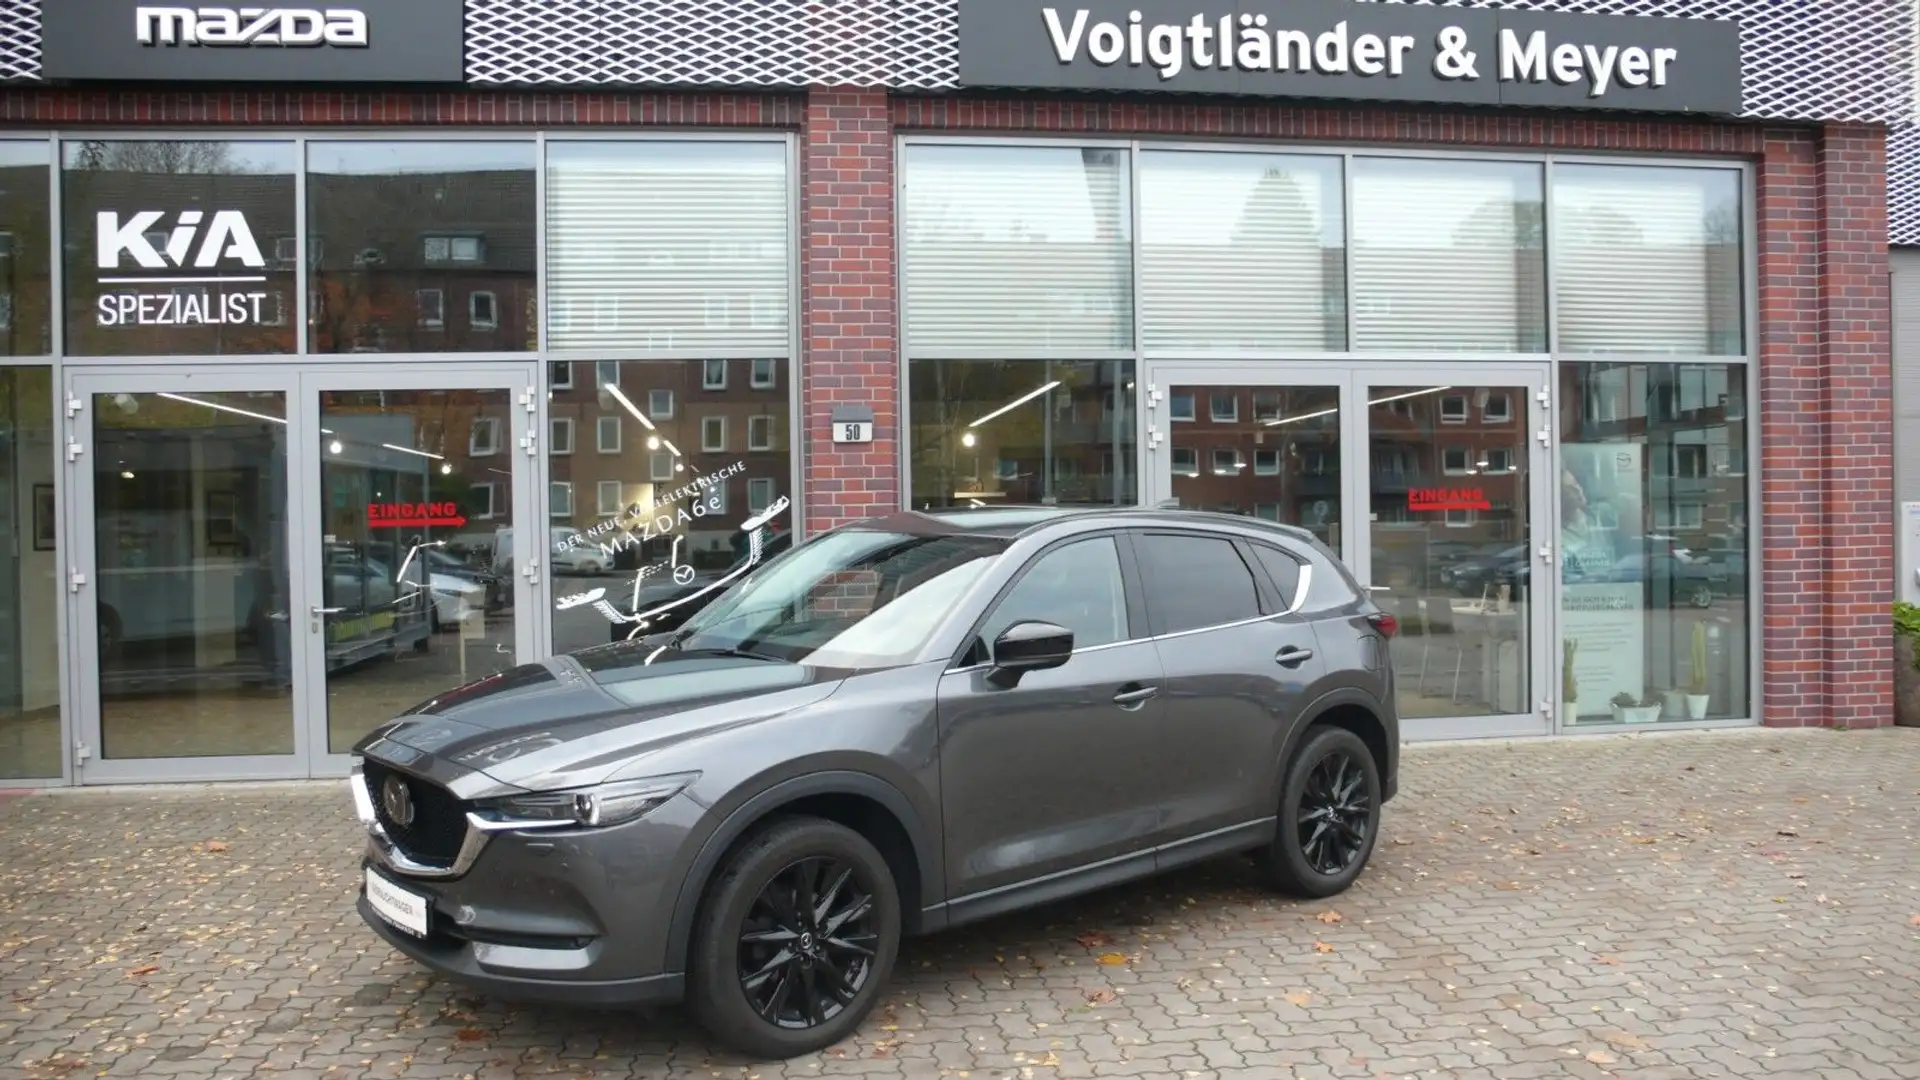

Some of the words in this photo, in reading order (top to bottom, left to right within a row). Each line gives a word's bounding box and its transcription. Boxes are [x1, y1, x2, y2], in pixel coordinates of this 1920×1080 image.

[1042, 7, 1417, 79] Voigtländer
[1435, 25, 1481, 79] &
[1501, 28, 1679, 96] Meyer
[97, 292, 267, 326] SPEZIALIST
[845, 424, 861, 441] 50
[1408, 487, 1484, 503] EINGANG
[367, 502, 457, 518] EINGANG
[556, 533, 584, 552] DER
